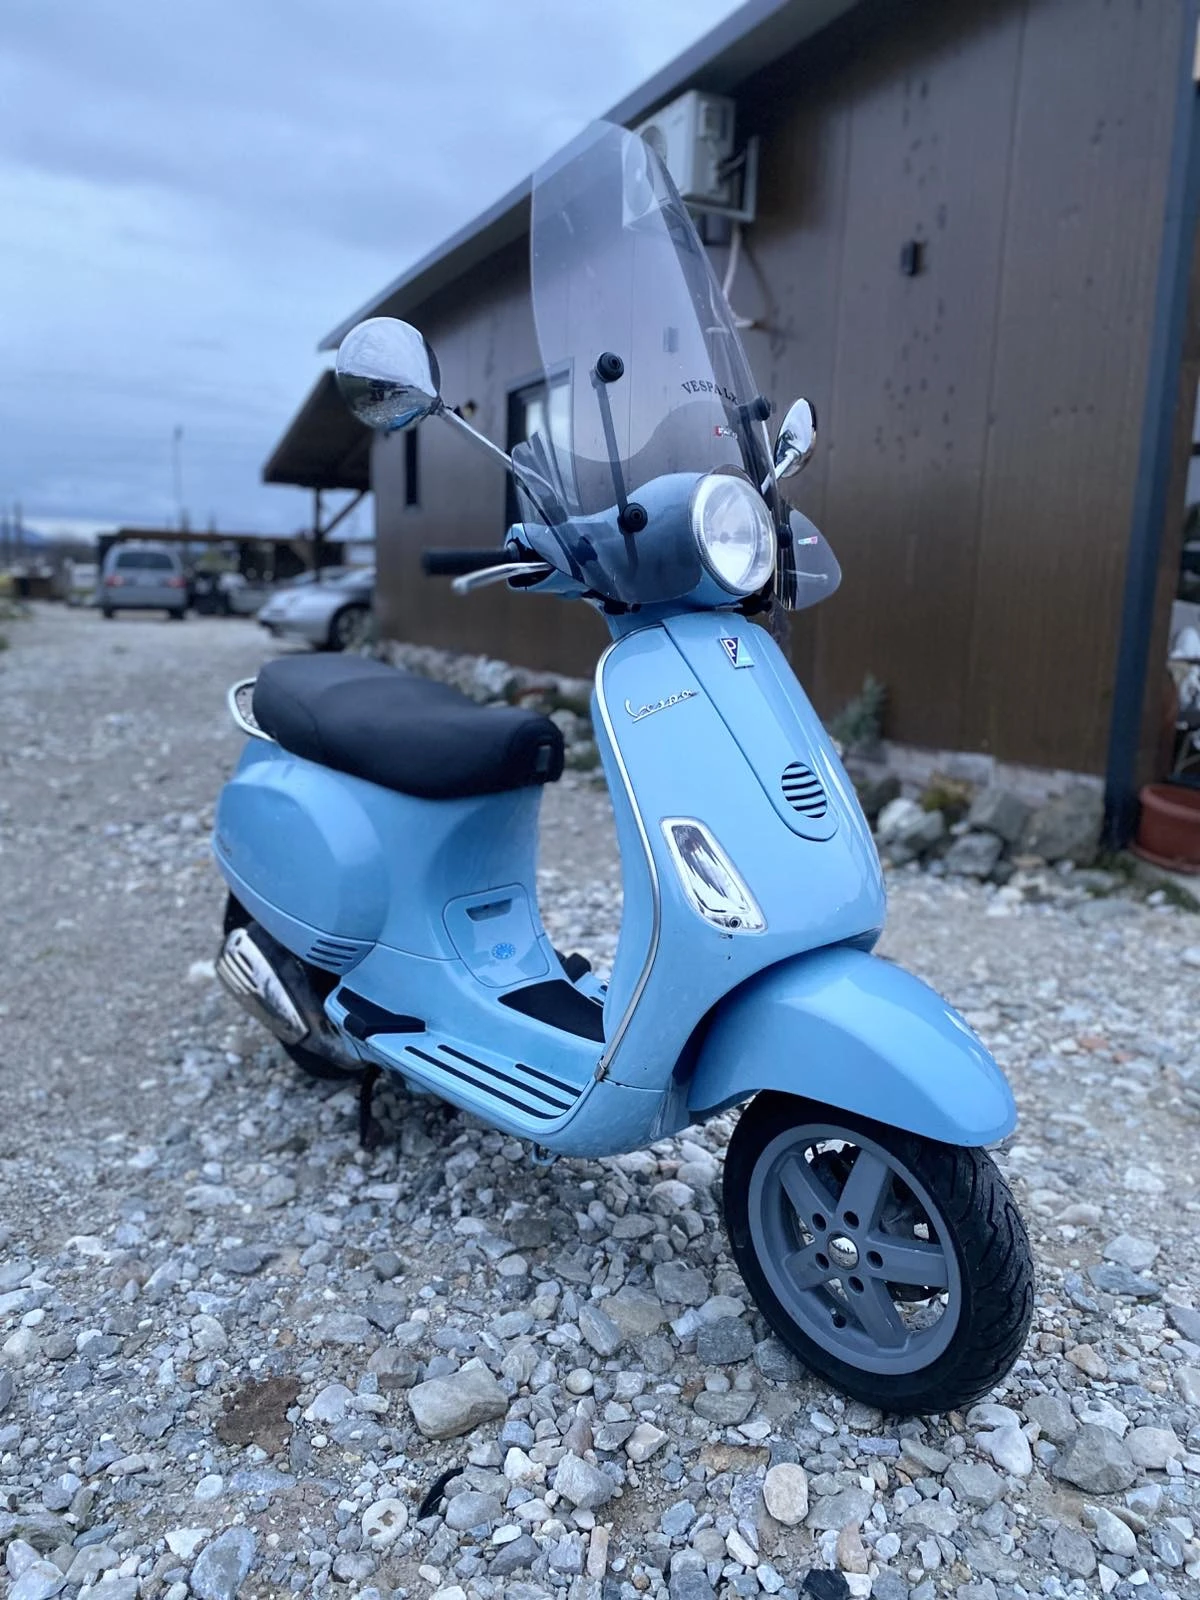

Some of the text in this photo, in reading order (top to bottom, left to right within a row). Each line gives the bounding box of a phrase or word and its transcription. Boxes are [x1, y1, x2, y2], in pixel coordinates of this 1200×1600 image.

[681, 380, 723, 396] VESPA
[724, 639, 737, 657] P
[624, 690, 699, 724] Vespa
